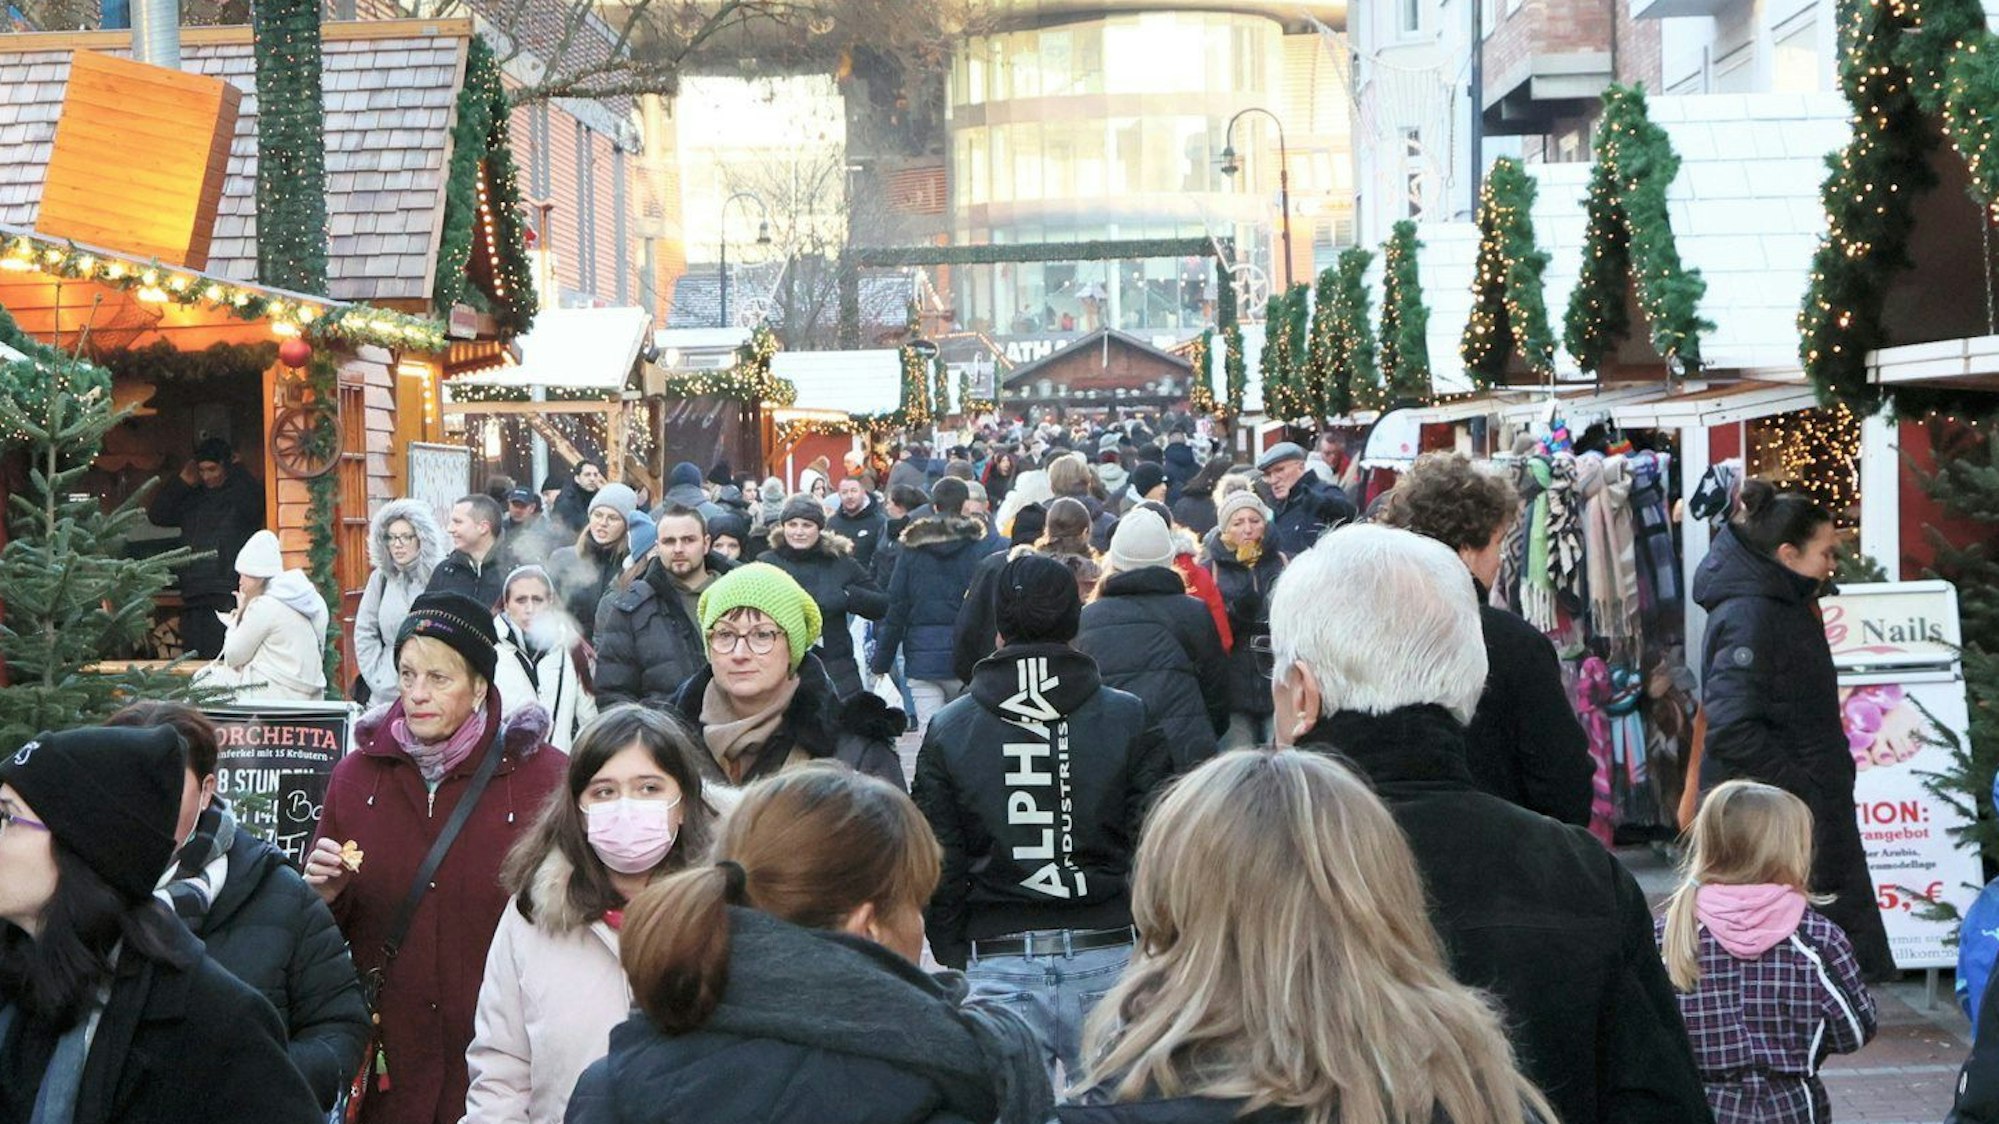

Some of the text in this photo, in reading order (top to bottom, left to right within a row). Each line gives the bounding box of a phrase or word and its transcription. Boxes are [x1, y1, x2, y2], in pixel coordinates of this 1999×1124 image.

[1861, 617, 1943, 644] Nails
[257, 748, 273, 757] mit
[275, 749, 285, 757] 15
[287, 749, 328, 762] Kräutern
